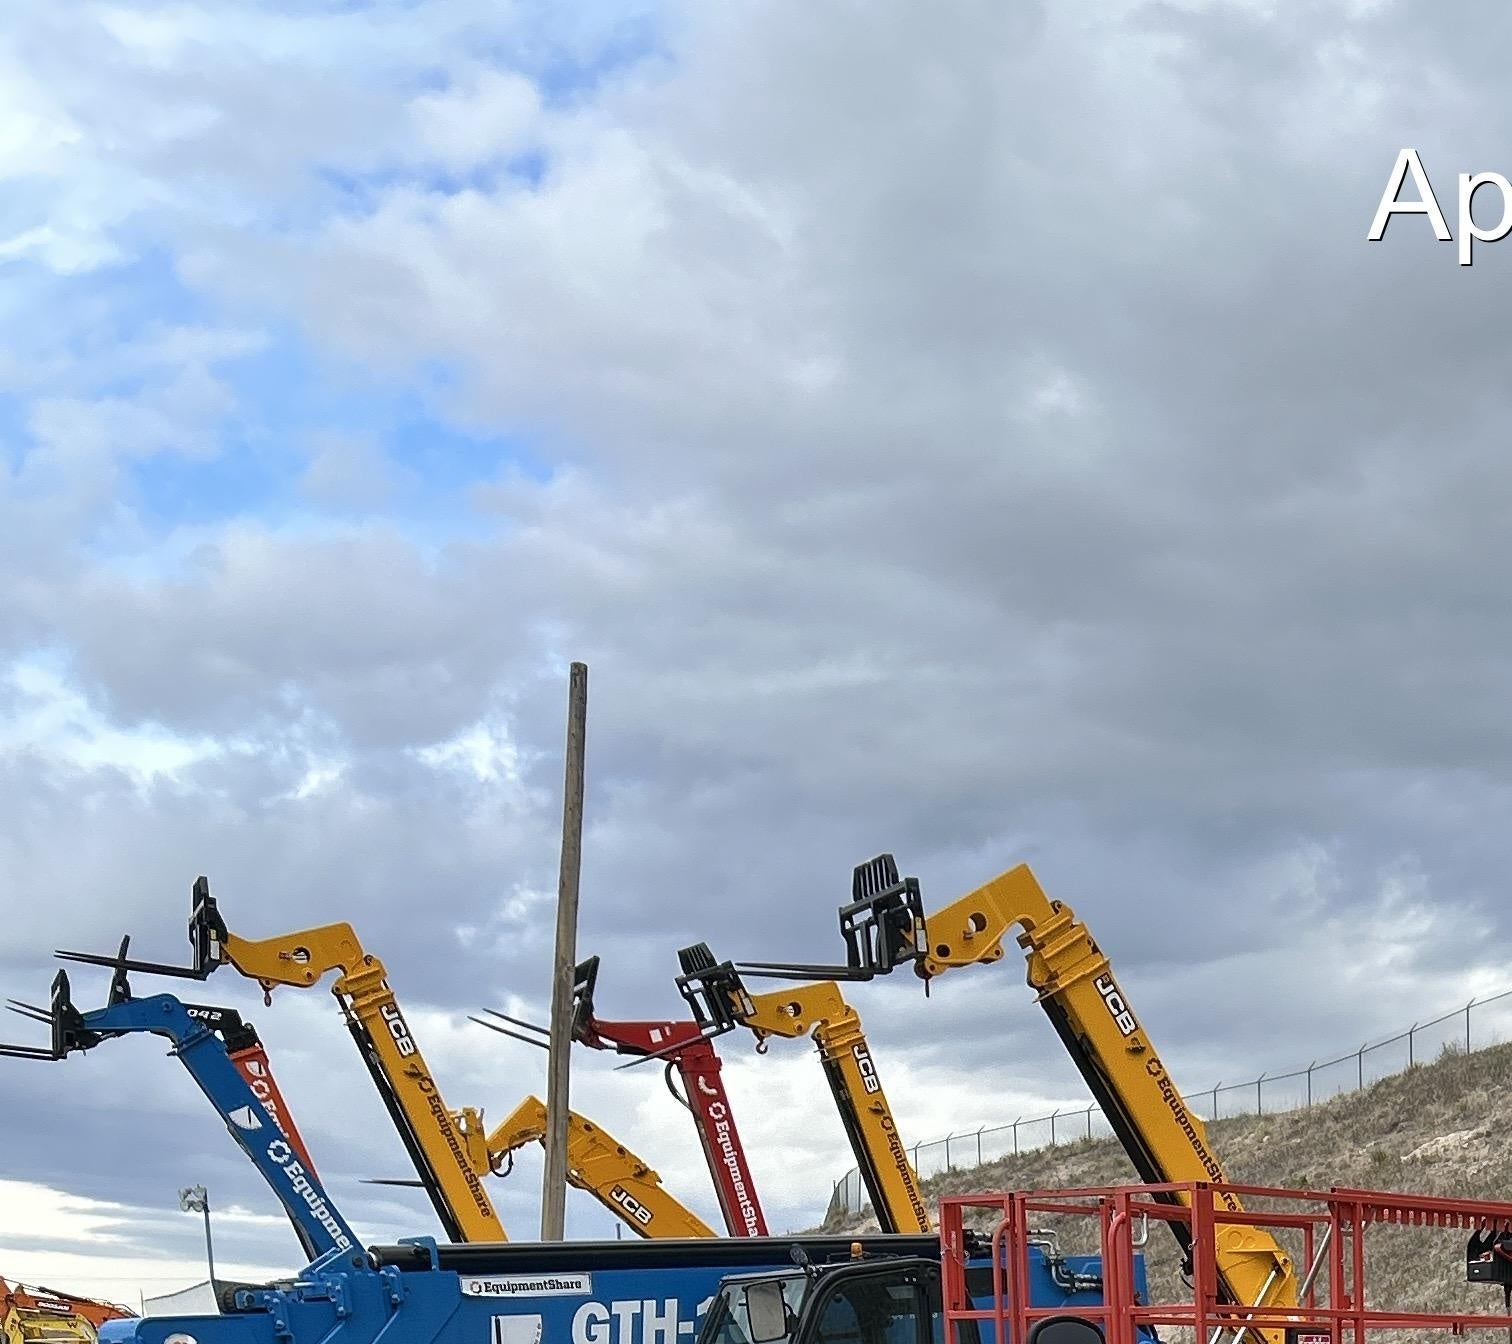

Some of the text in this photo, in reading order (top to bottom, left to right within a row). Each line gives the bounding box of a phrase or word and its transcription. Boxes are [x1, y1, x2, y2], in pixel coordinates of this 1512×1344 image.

[381, 1005, 416, 1057] JCB
[1095, 976, 1137, 1036] JCB
[853, 1044, 880, 1094] JCB
[426, 1092, 492, 1218] EquipmentShare
[1156, 1076, 1243, 1212] EquipmentShre
[610, 1188, 652, 1224] JCB
[483, 1278, 583, 1295] EquipmentShare
